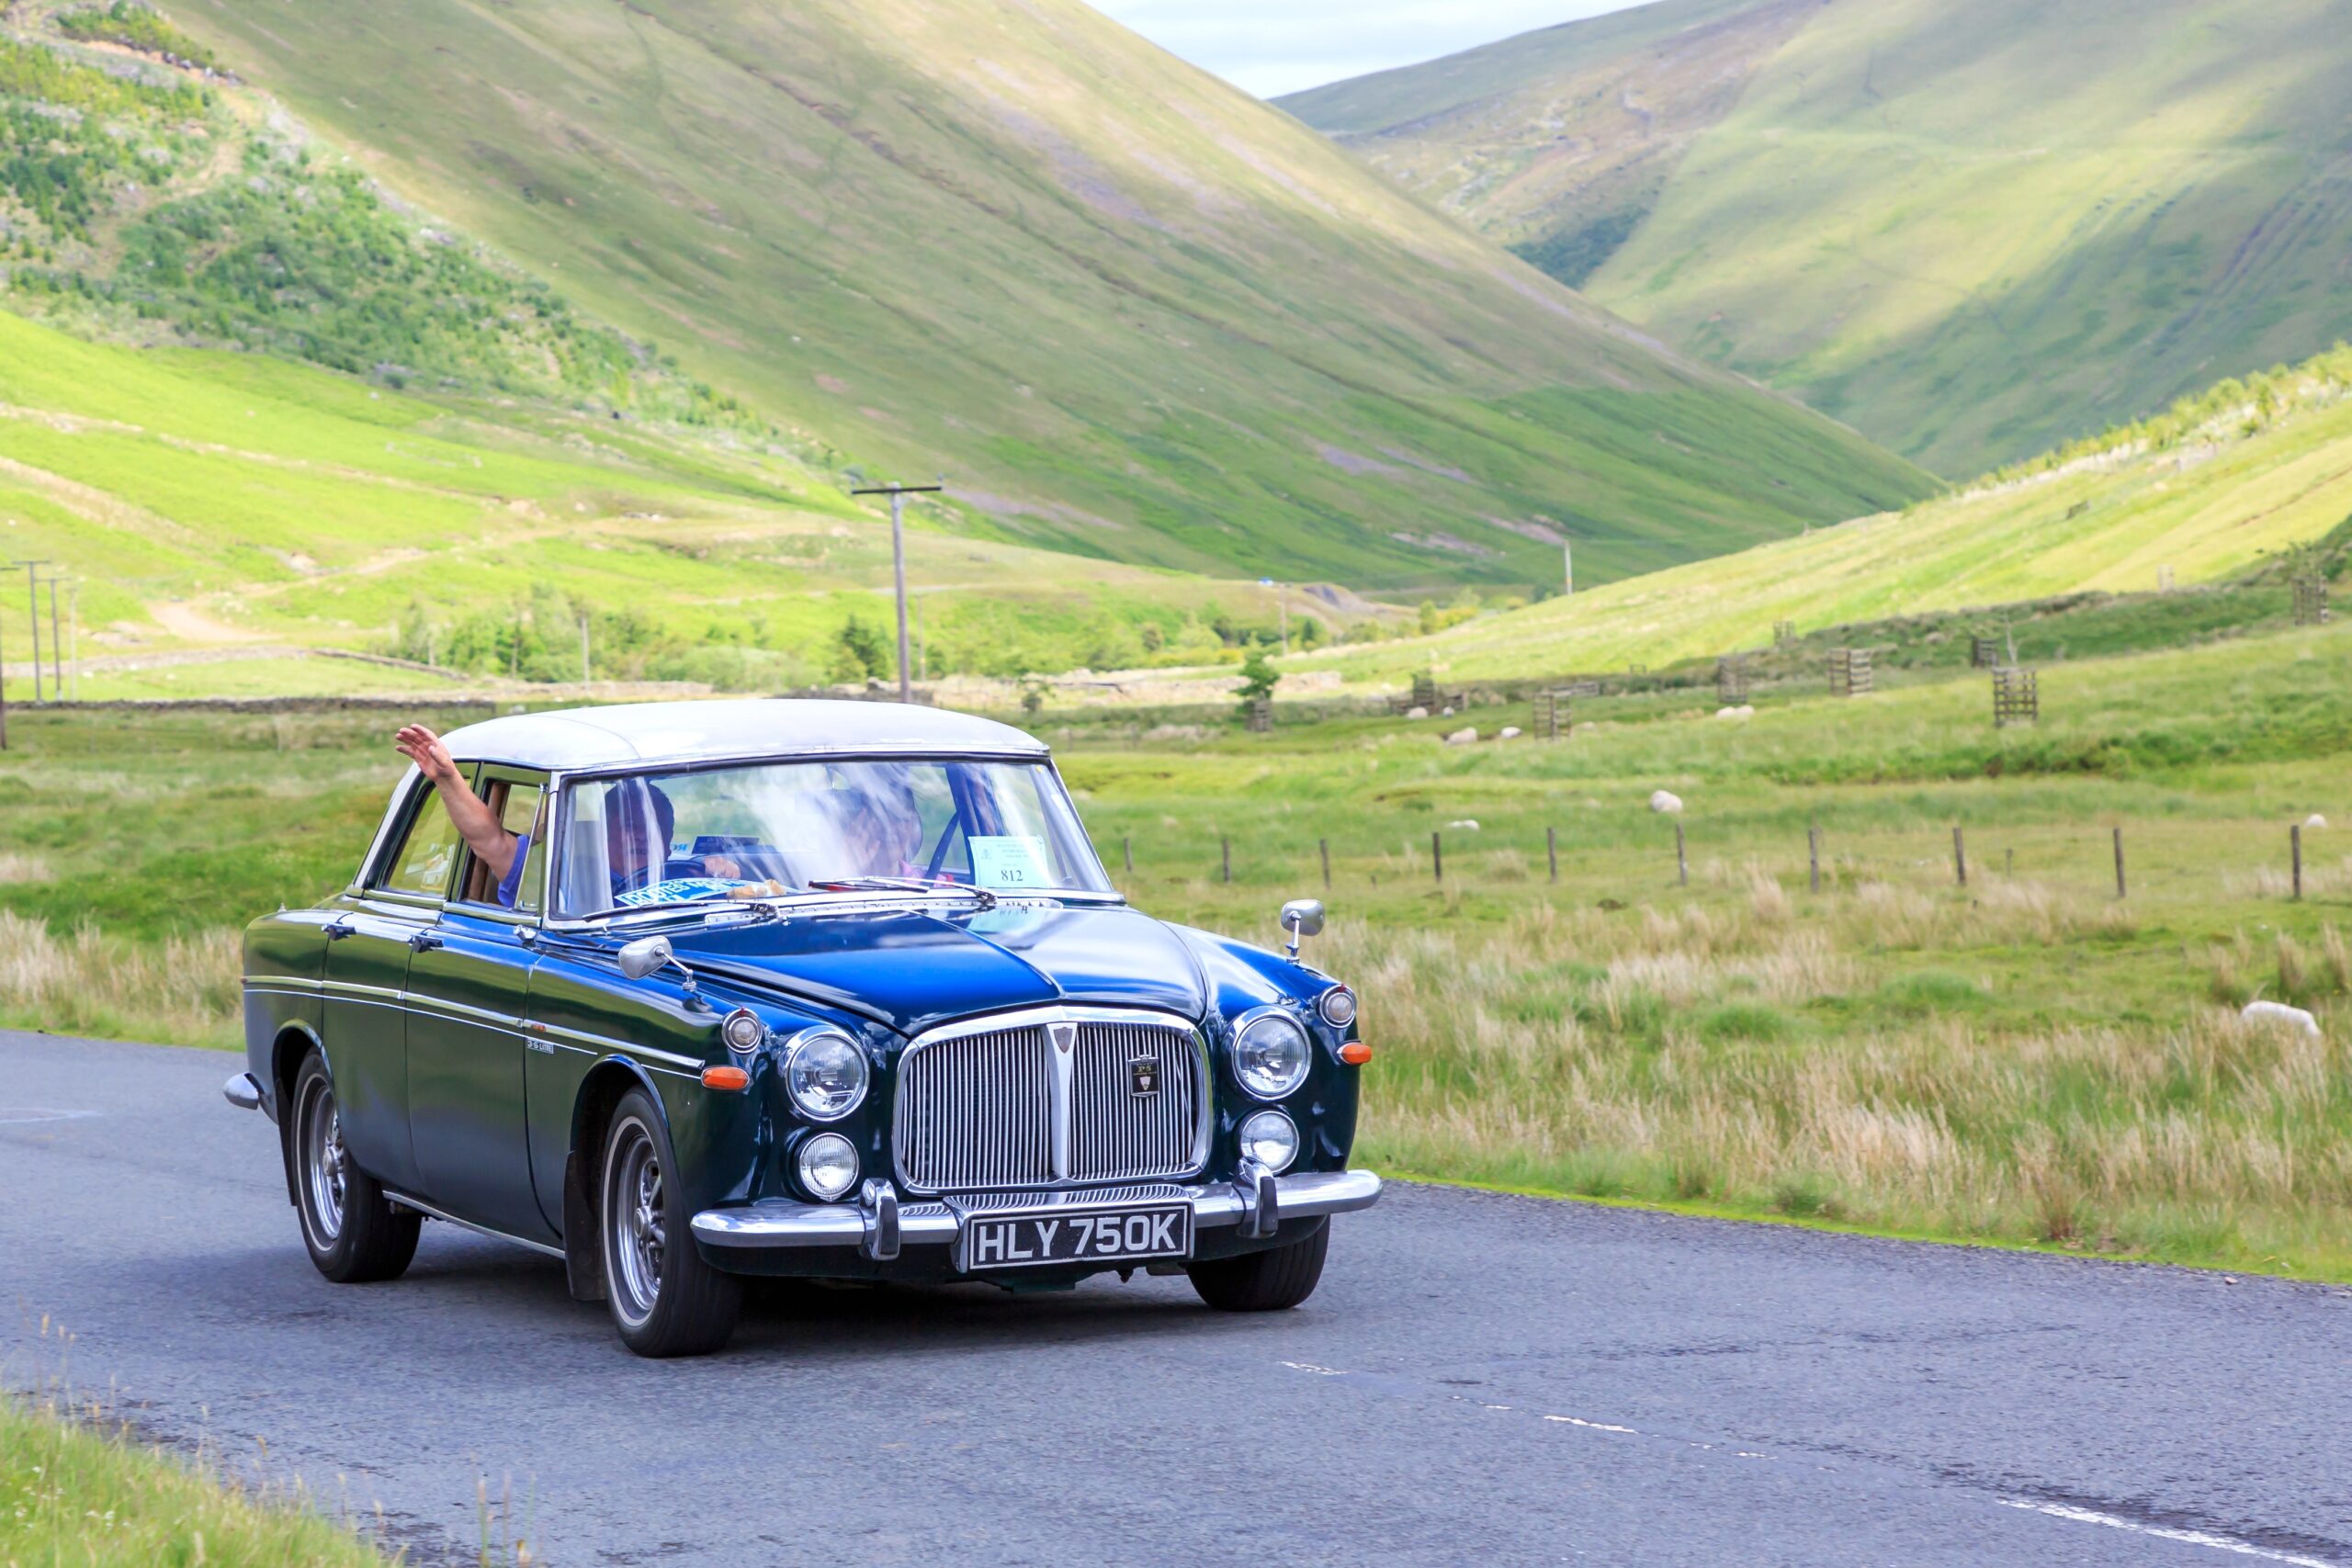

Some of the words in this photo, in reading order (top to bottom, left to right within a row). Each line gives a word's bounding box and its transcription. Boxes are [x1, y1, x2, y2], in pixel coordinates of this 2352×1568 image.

[1001, 869, 1023, 882] 812
[978, 1220, 1060, 1263] HLY
[1069, 1213, 1179, 1256] 750K
